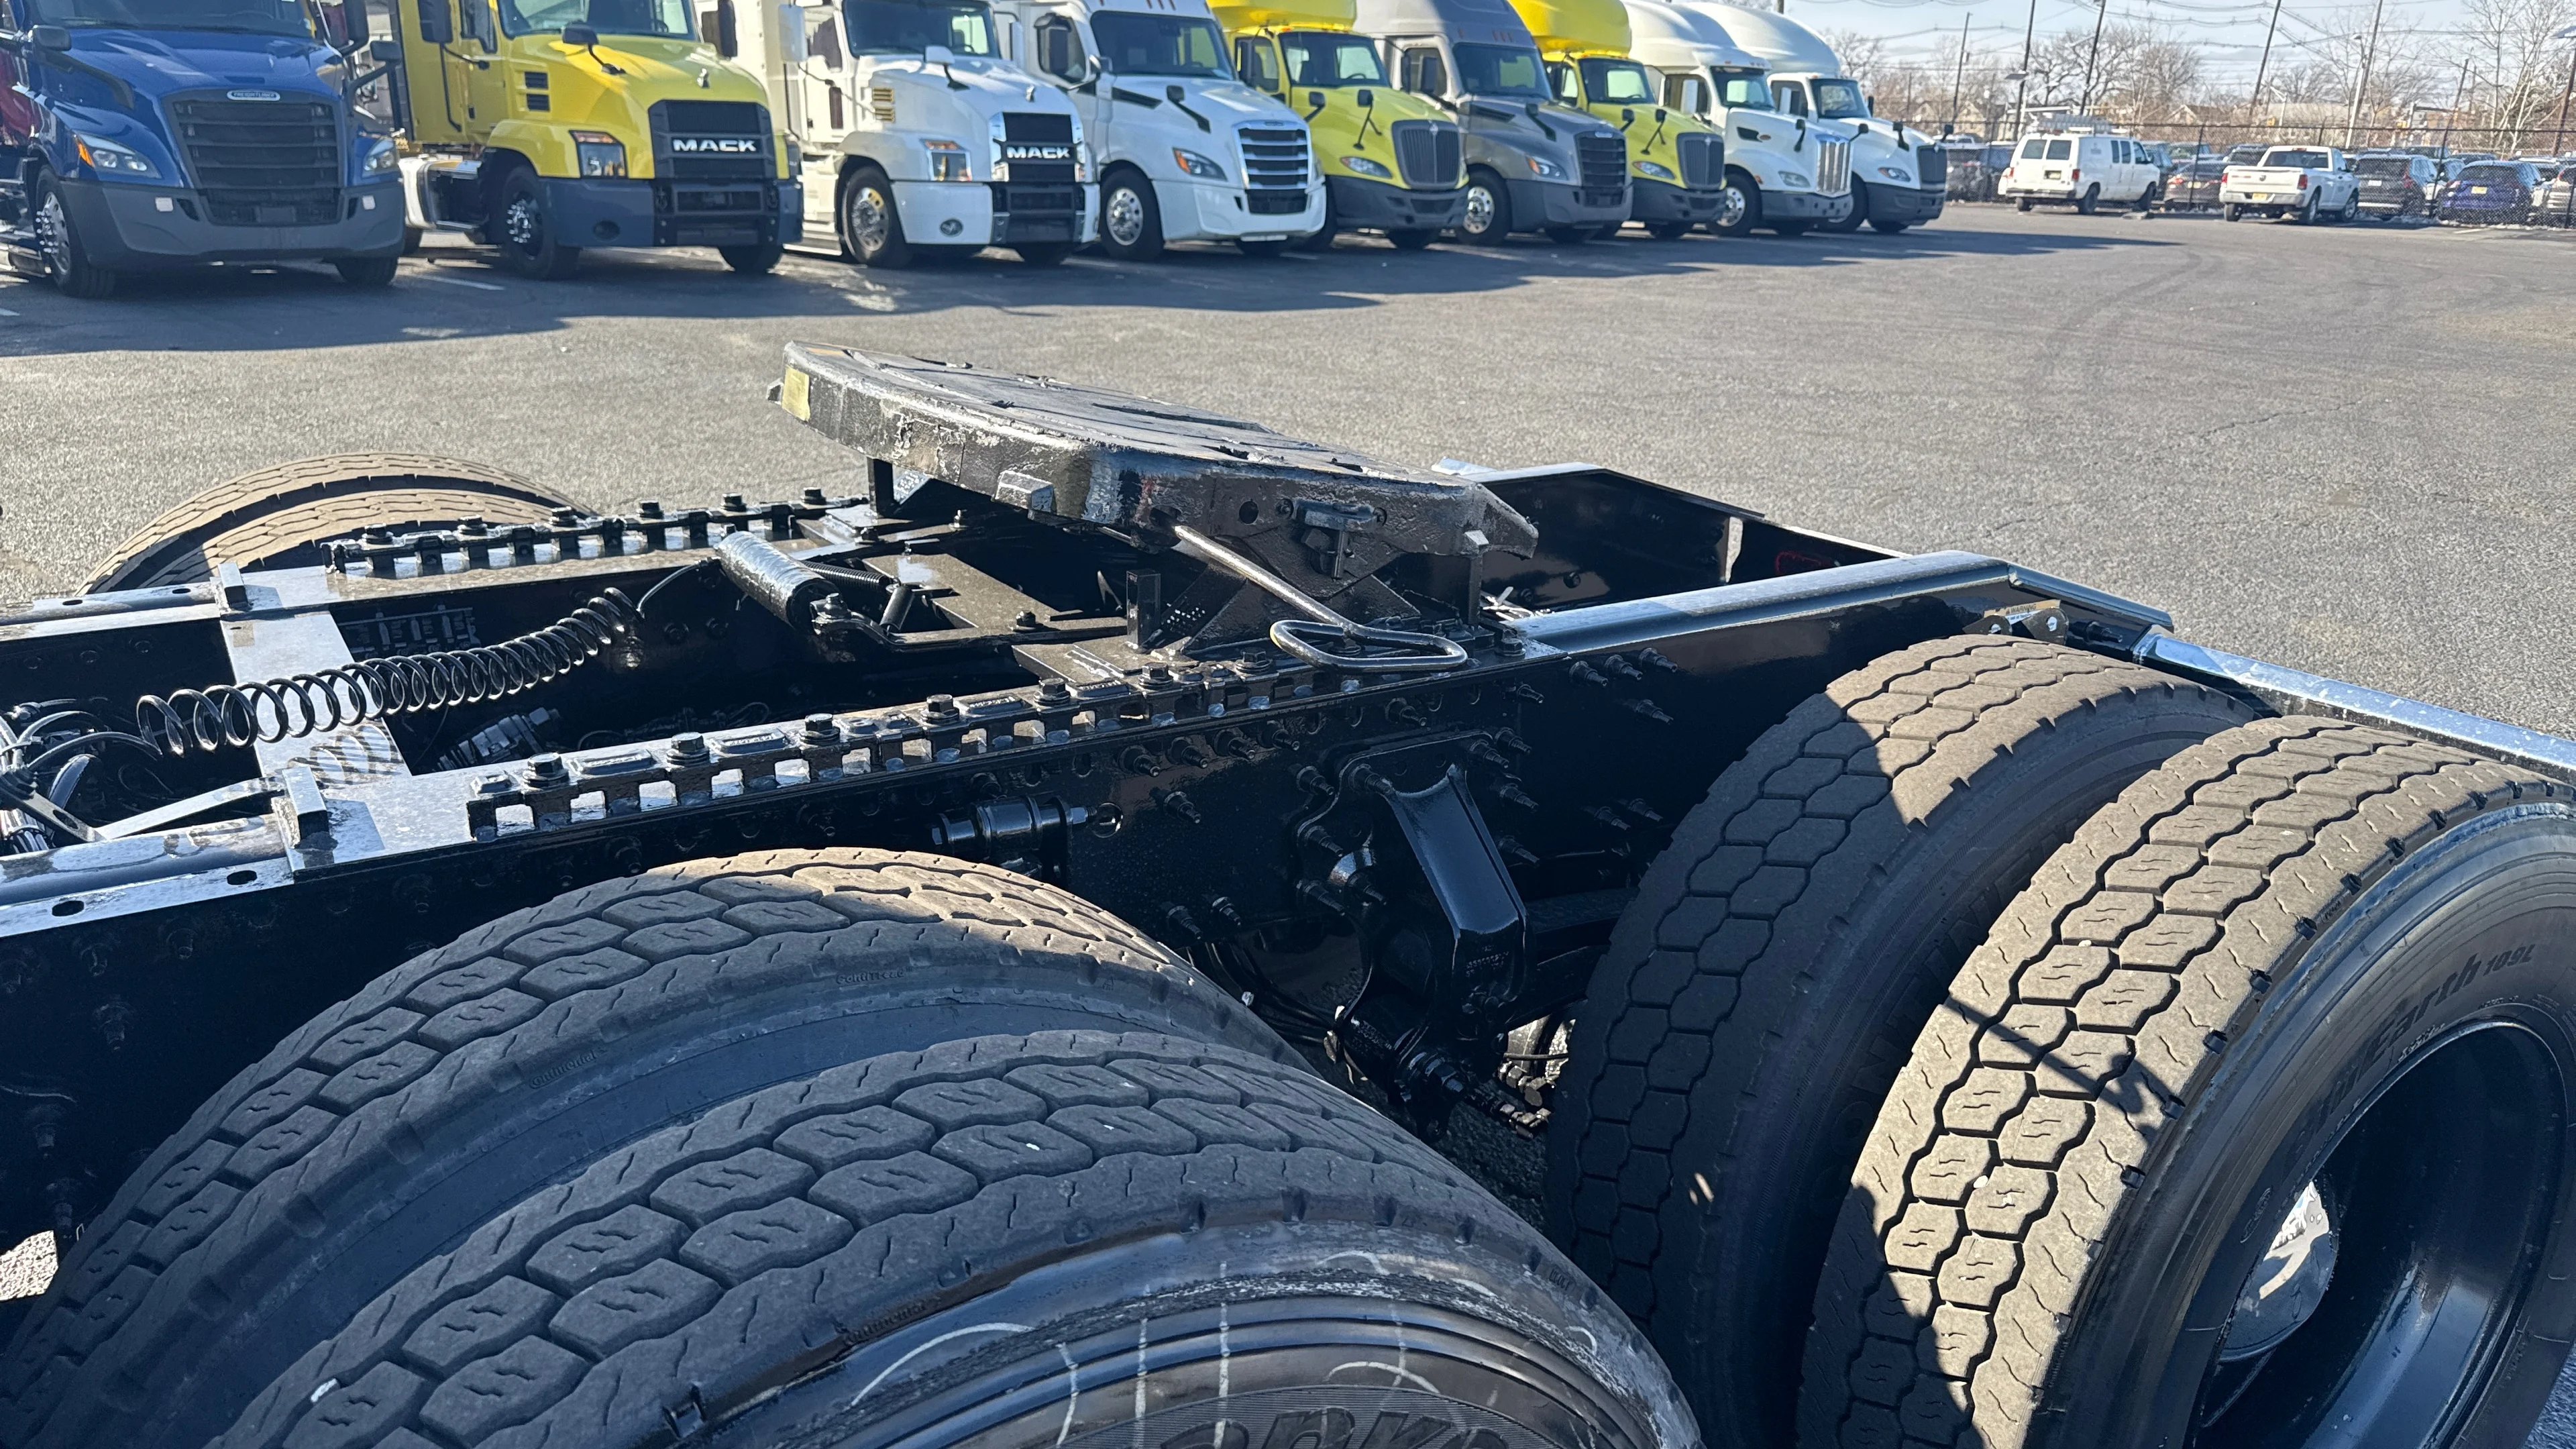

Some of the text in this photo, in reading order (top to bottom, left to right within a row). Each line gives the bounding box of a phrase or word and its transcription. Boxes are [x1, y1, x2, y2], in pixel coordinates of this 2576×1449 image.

[673, 138, 757, 152] MACK
[1006, 146, 1070, 159] MACK
[2483, 944, 2536, 977] 109L
